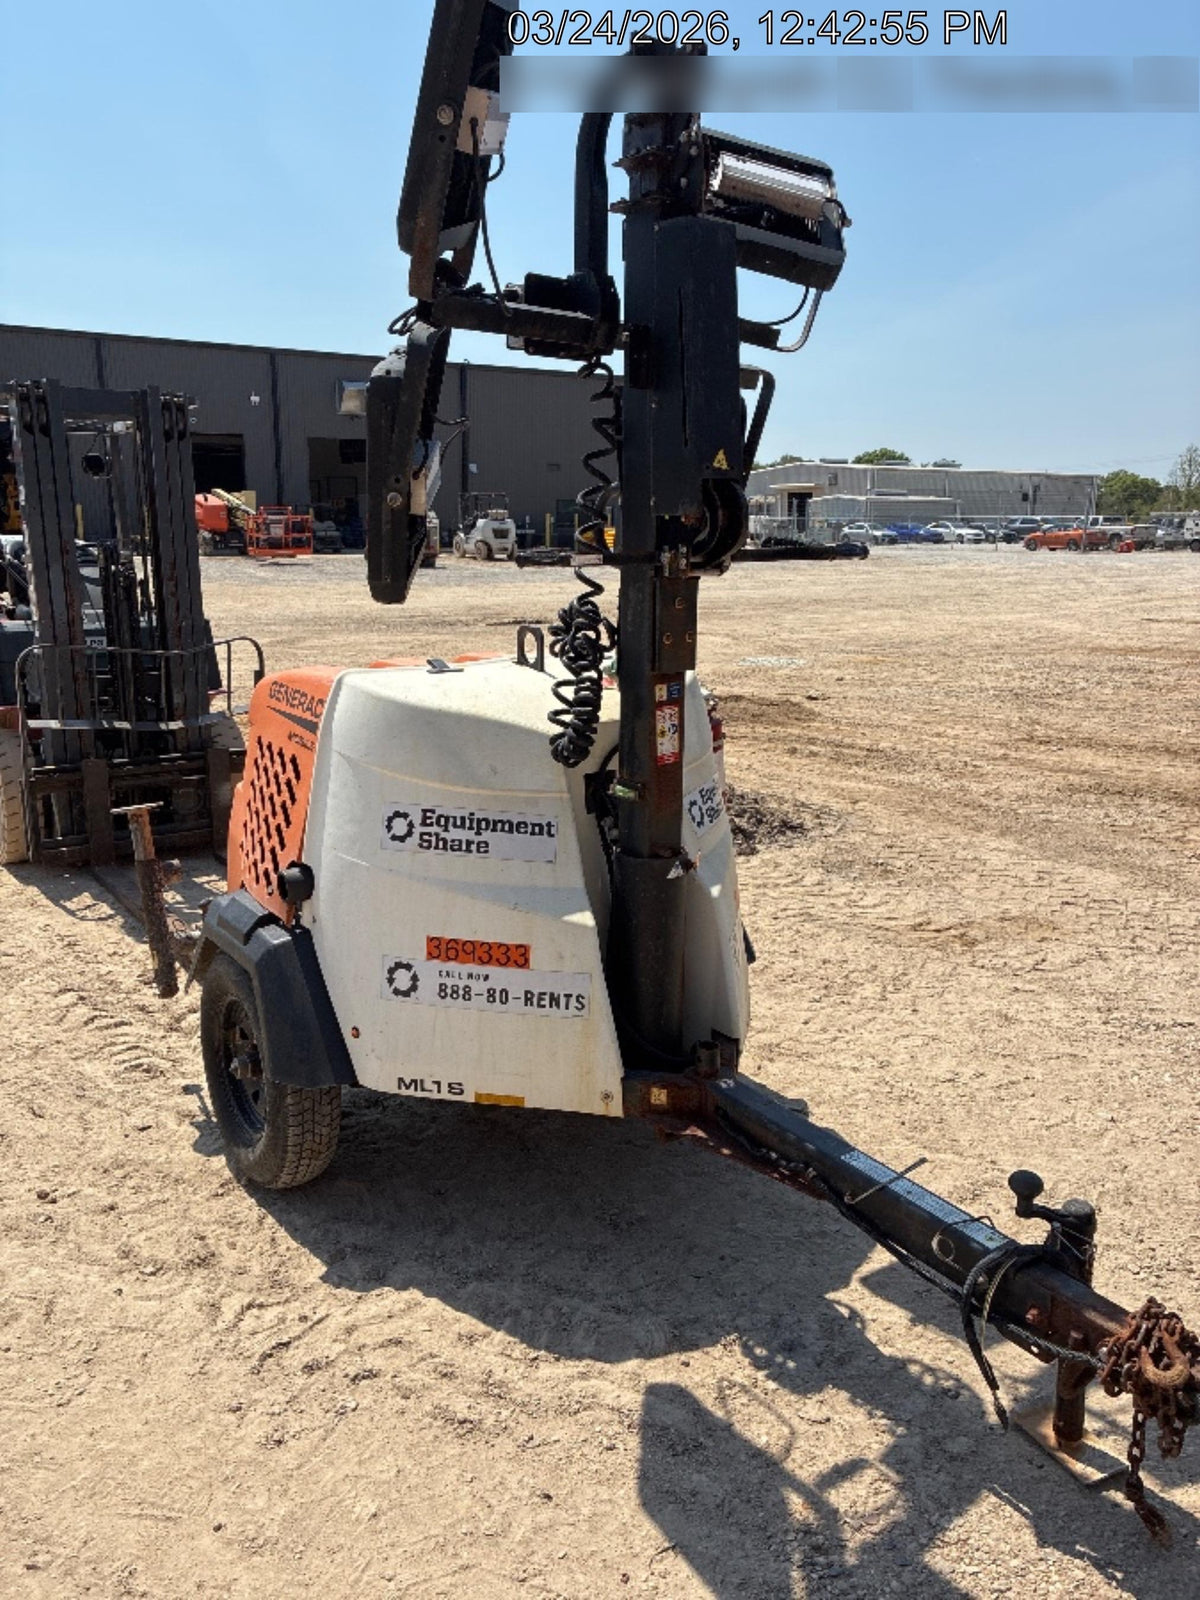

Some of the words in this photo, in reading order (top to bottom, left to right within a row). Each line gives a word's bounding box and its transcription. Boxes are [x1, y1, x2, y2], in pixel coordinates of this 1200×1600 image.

[269, 680, 326, 718] GENERAC
[419, 808, 556, 838] Equipment
[418, 832, 490, 854] Share
[428, 937, 529, 968] 369333
[438, 970, 463, 980] CALL
[467, 974, 490, 982] NOW
[437, 982, 586, 1011] 888-80-RENTS
